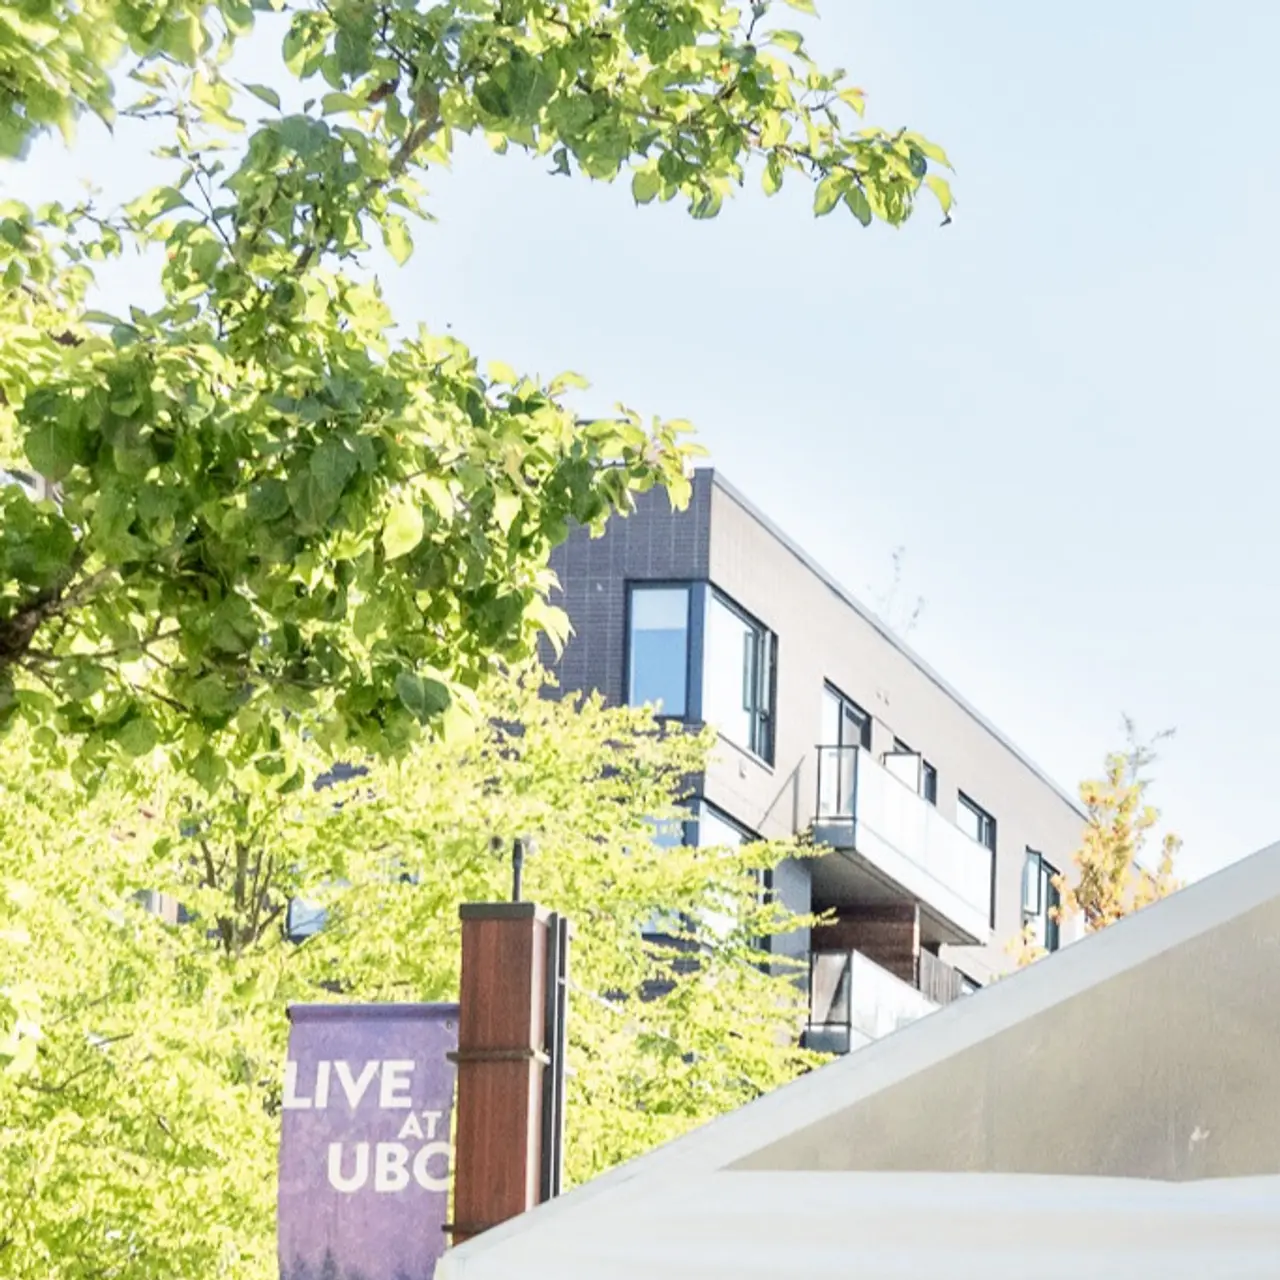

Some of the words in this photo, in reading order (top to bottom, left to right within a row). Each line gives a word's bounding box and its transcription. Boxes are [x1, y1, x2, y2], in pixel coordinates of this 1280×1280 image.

[281, 1059, 416, 1109] LIVE
[397, 1110, 443, 1140] AT
[328, 1141, 454, 1194] UBC
